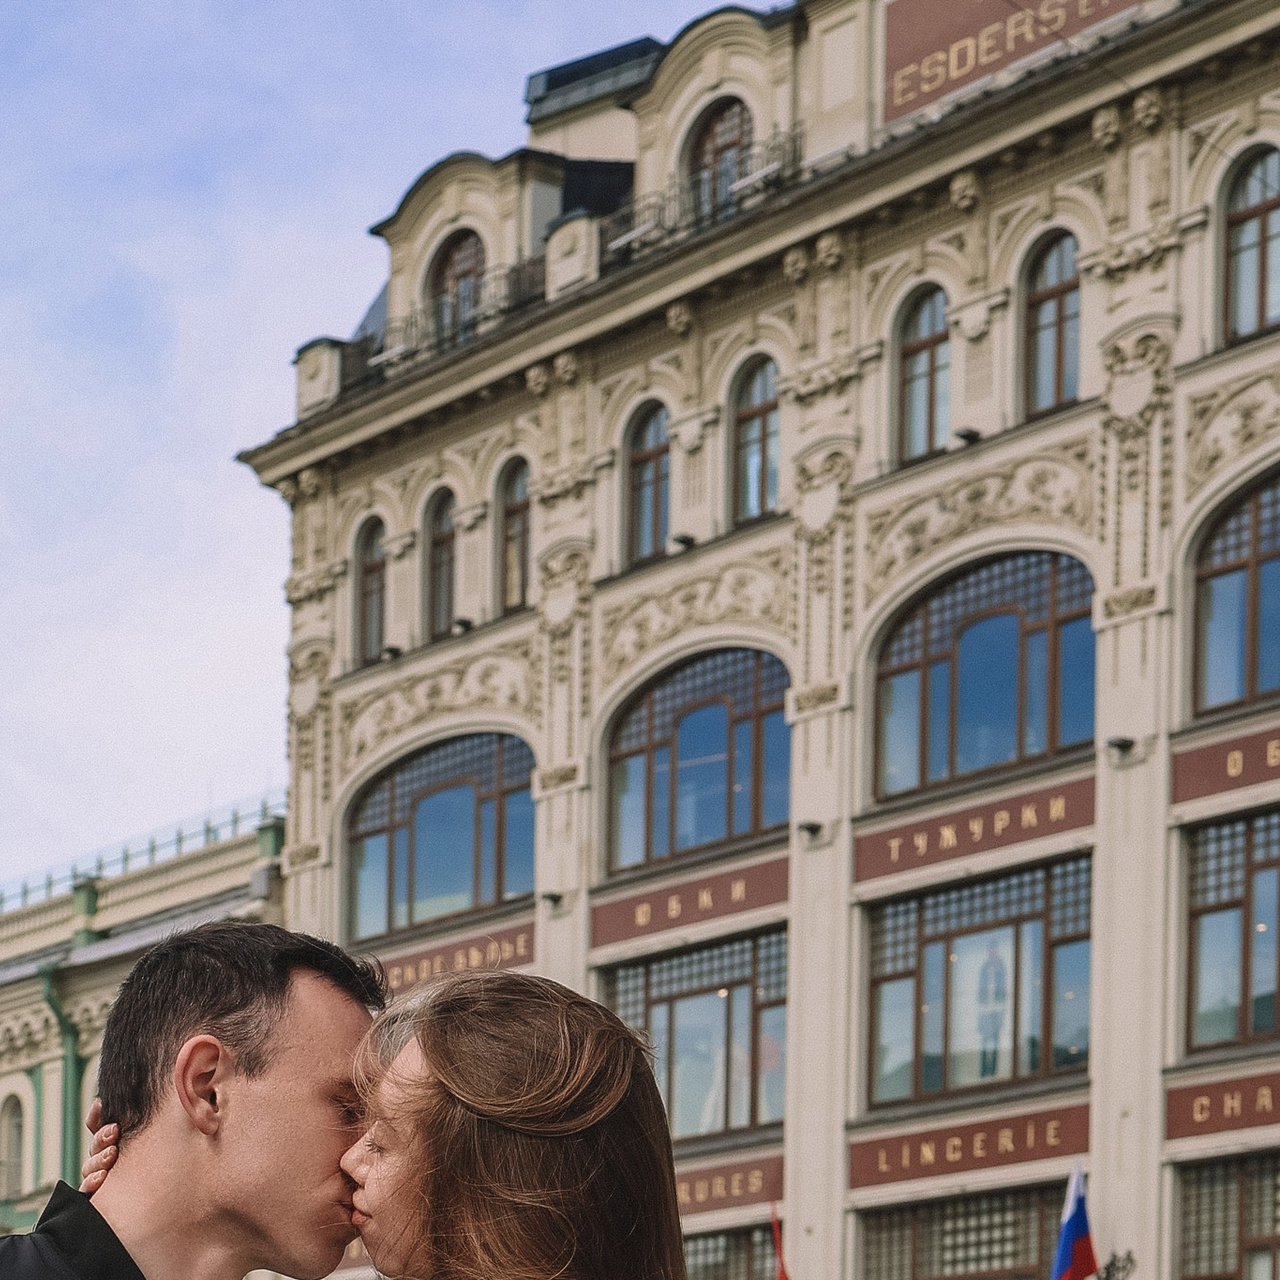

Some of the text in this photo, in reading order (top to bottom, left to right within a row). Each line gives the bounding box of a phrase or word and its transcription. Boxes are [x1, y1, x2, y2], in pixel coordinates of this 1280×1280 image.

[892, 0, 1068, 107] ESDERS
[886, 795, 1066, 864] ТУЖУРКИ
[634, 878, 746, 928] ЮБКИ
[878, 1119, 1062, 1173] LINGERIE
